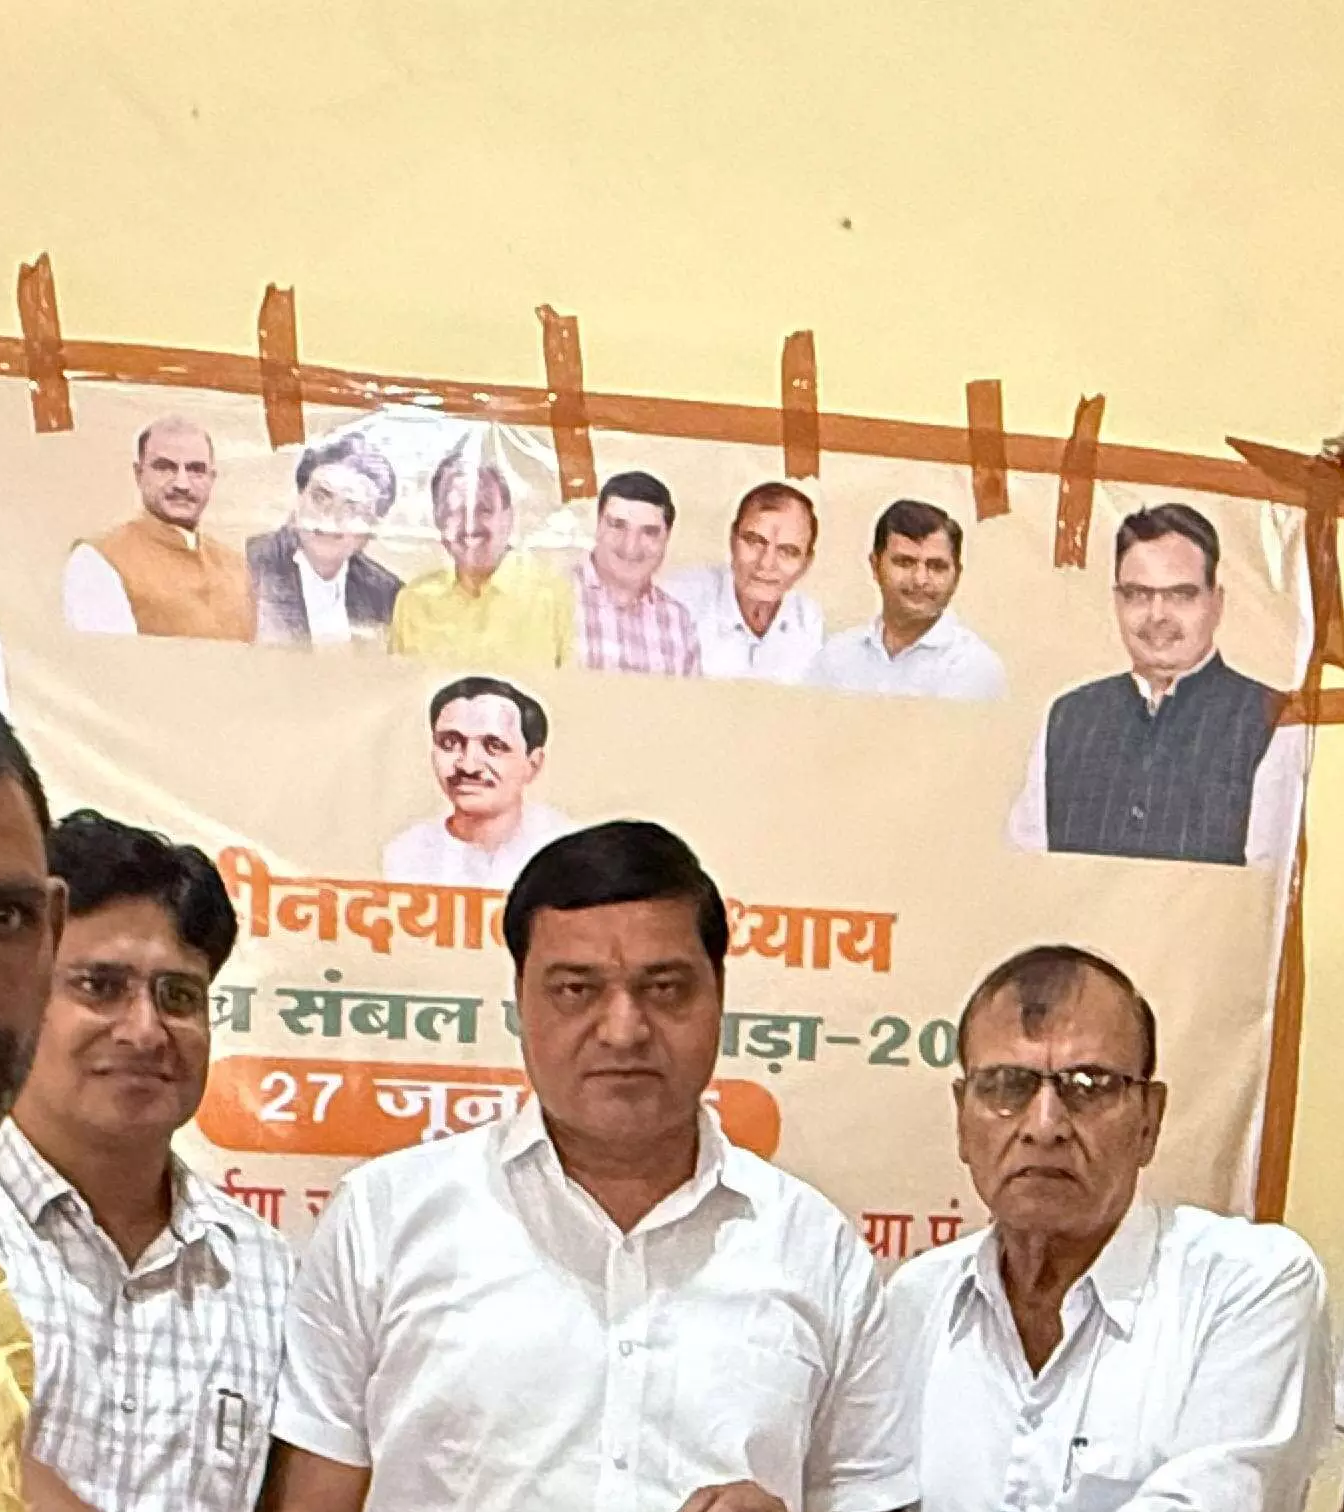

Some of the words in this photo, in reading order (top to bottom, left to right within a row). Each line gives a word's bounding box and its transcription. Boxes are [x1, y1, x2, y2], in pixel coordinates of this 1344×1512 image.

[218, 846, 505, 953] ीनदया
[275, 968, 484, 1043] संबल
[258, 1071, 344, 1124] 27
[372, 1078, 525, 1146] जून
